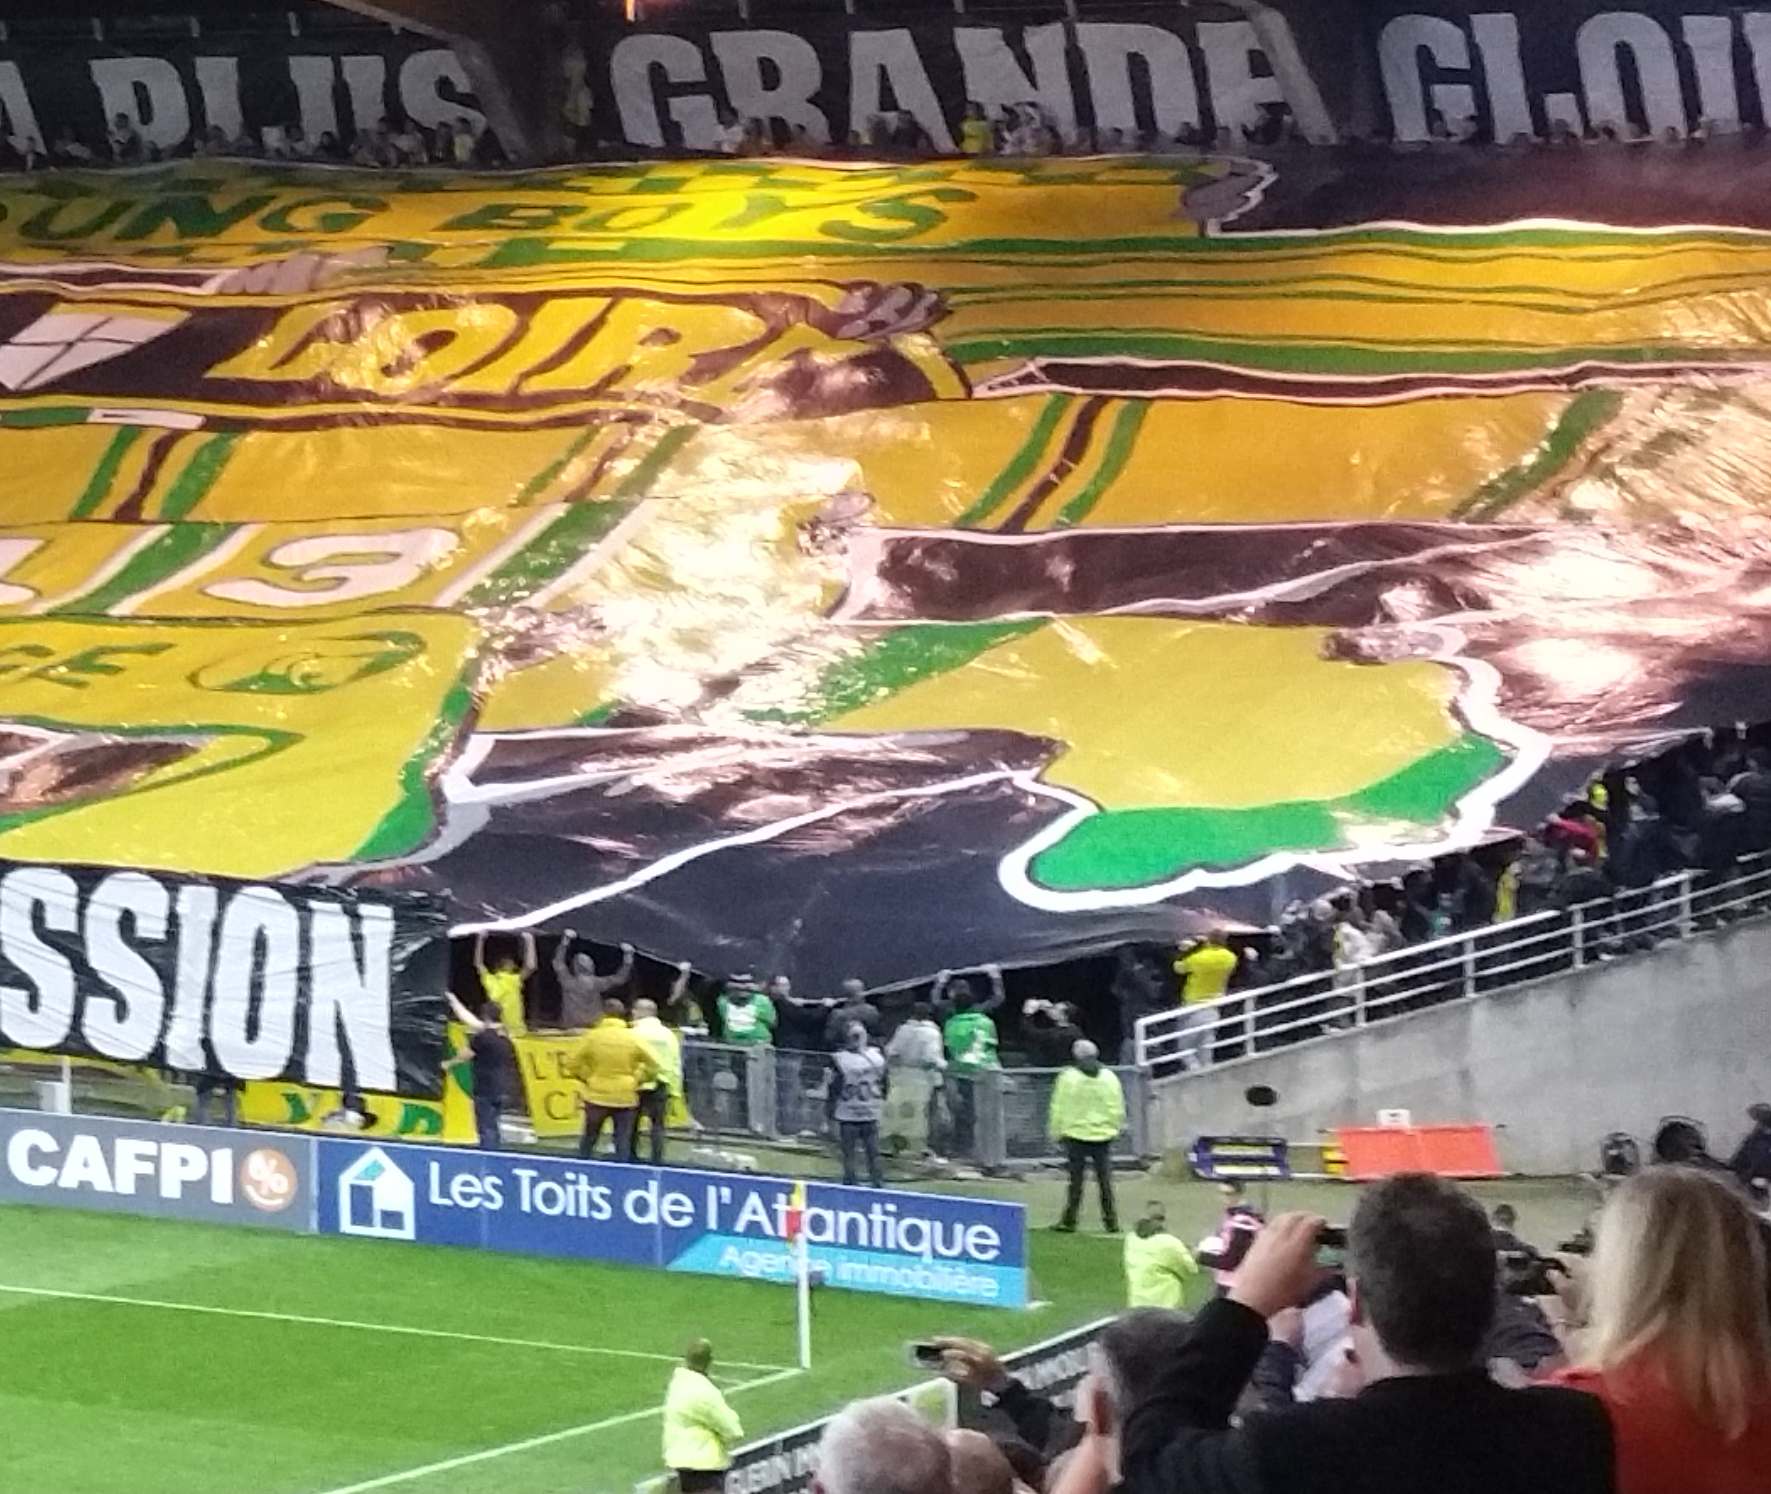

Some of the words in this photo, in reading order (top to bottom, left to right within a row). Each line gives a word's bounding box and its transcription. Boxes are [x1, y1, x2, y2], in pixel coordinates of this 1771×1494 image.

[444, 186, 978, 243] BOYS
[5, 1126, 234, 1205] CAFPI
[429, 1159, 504, 1211] Les
[512, 1167, 615, 1220] Toits
[623, 1178, 696, 1228] de
